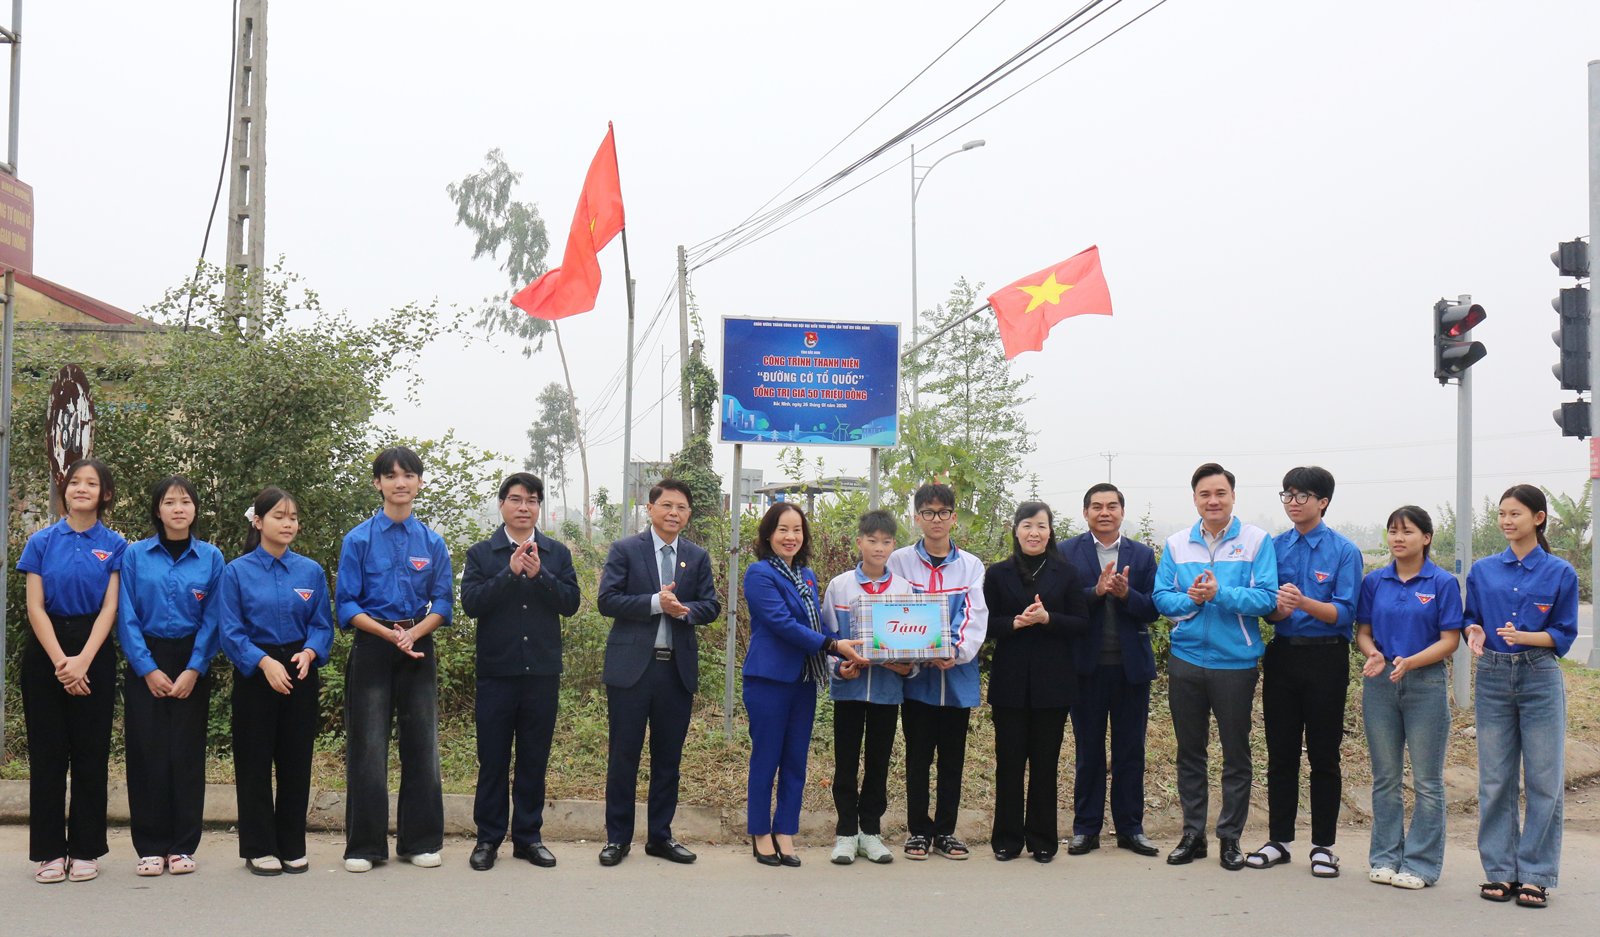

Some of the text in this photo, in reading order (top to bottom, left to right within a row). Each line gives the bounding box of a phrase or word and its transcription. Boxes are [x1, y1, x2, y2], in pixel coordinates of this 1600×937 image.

[763, 355, 859, 368] CÔNG TRÌNH THANH NIÊN
[800, 371, 814, 384] CỜ
[816, 370, 829, 384] TỔ
[753, 384, 867, 401] TỔNG TRỊ GIÁ 50 TRIỆU ĐỒNG
[886, 620, 929, 636] Tặng
